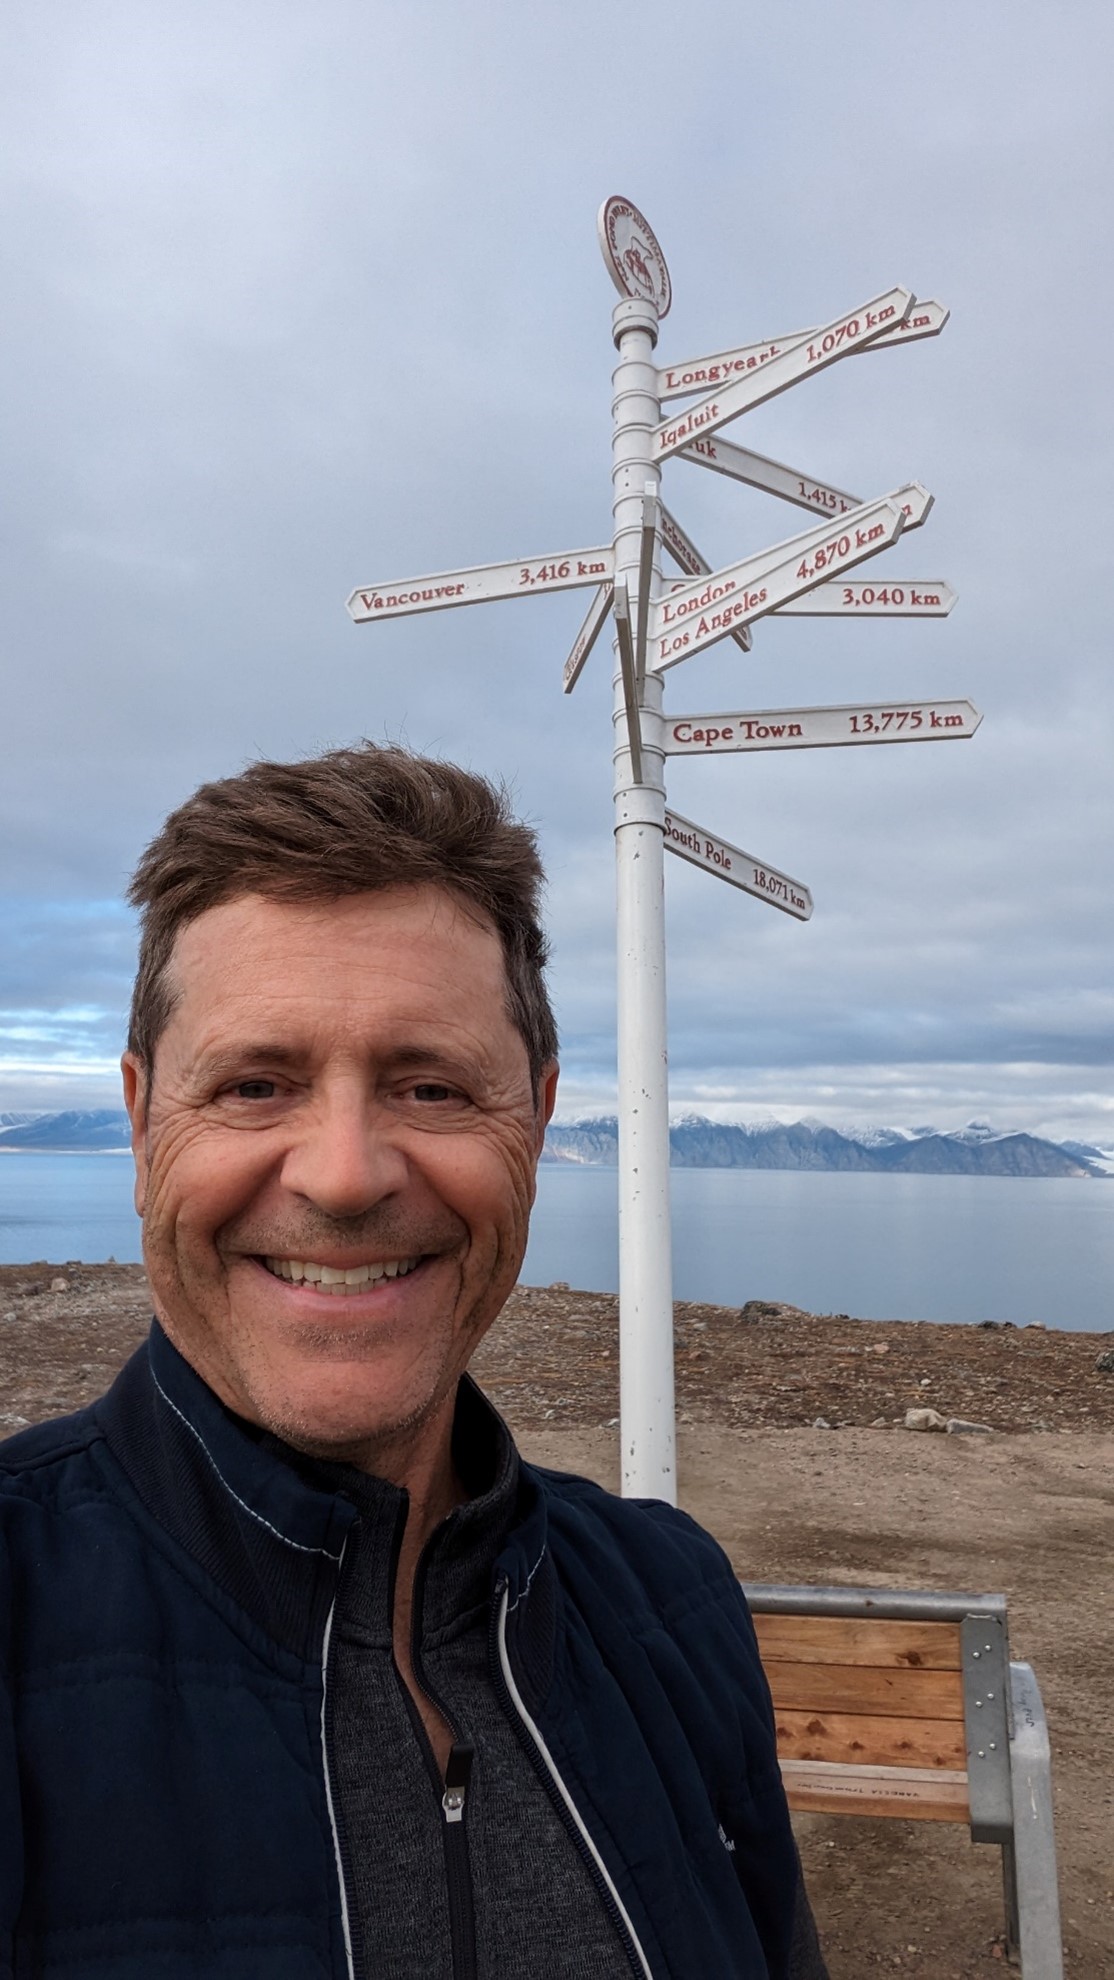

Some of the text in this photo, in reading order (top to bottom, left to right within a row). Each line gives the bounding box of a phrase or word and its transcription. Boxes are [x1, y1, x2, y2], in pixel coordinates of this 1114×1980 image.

[659, 303, 896, 450] Iqaluit 1,070 km
[798, 482, 837, 510] 1,415
[360, 559, 607, 611] Vancouver 3,416 km
[660, 631, 689, 659] Los
[694, 587, 768, 640] Angeles
[796, 535, 851, 581] 4,870
[855, 522, 885, 549] km
[662, 580, 736, 624] London
[842, 588, 941, 607] 3,040 km
[673, 709, 964, 747] Cape Town 13,775 km
[664, 816, 806, 911] South Pole 18,071 km
